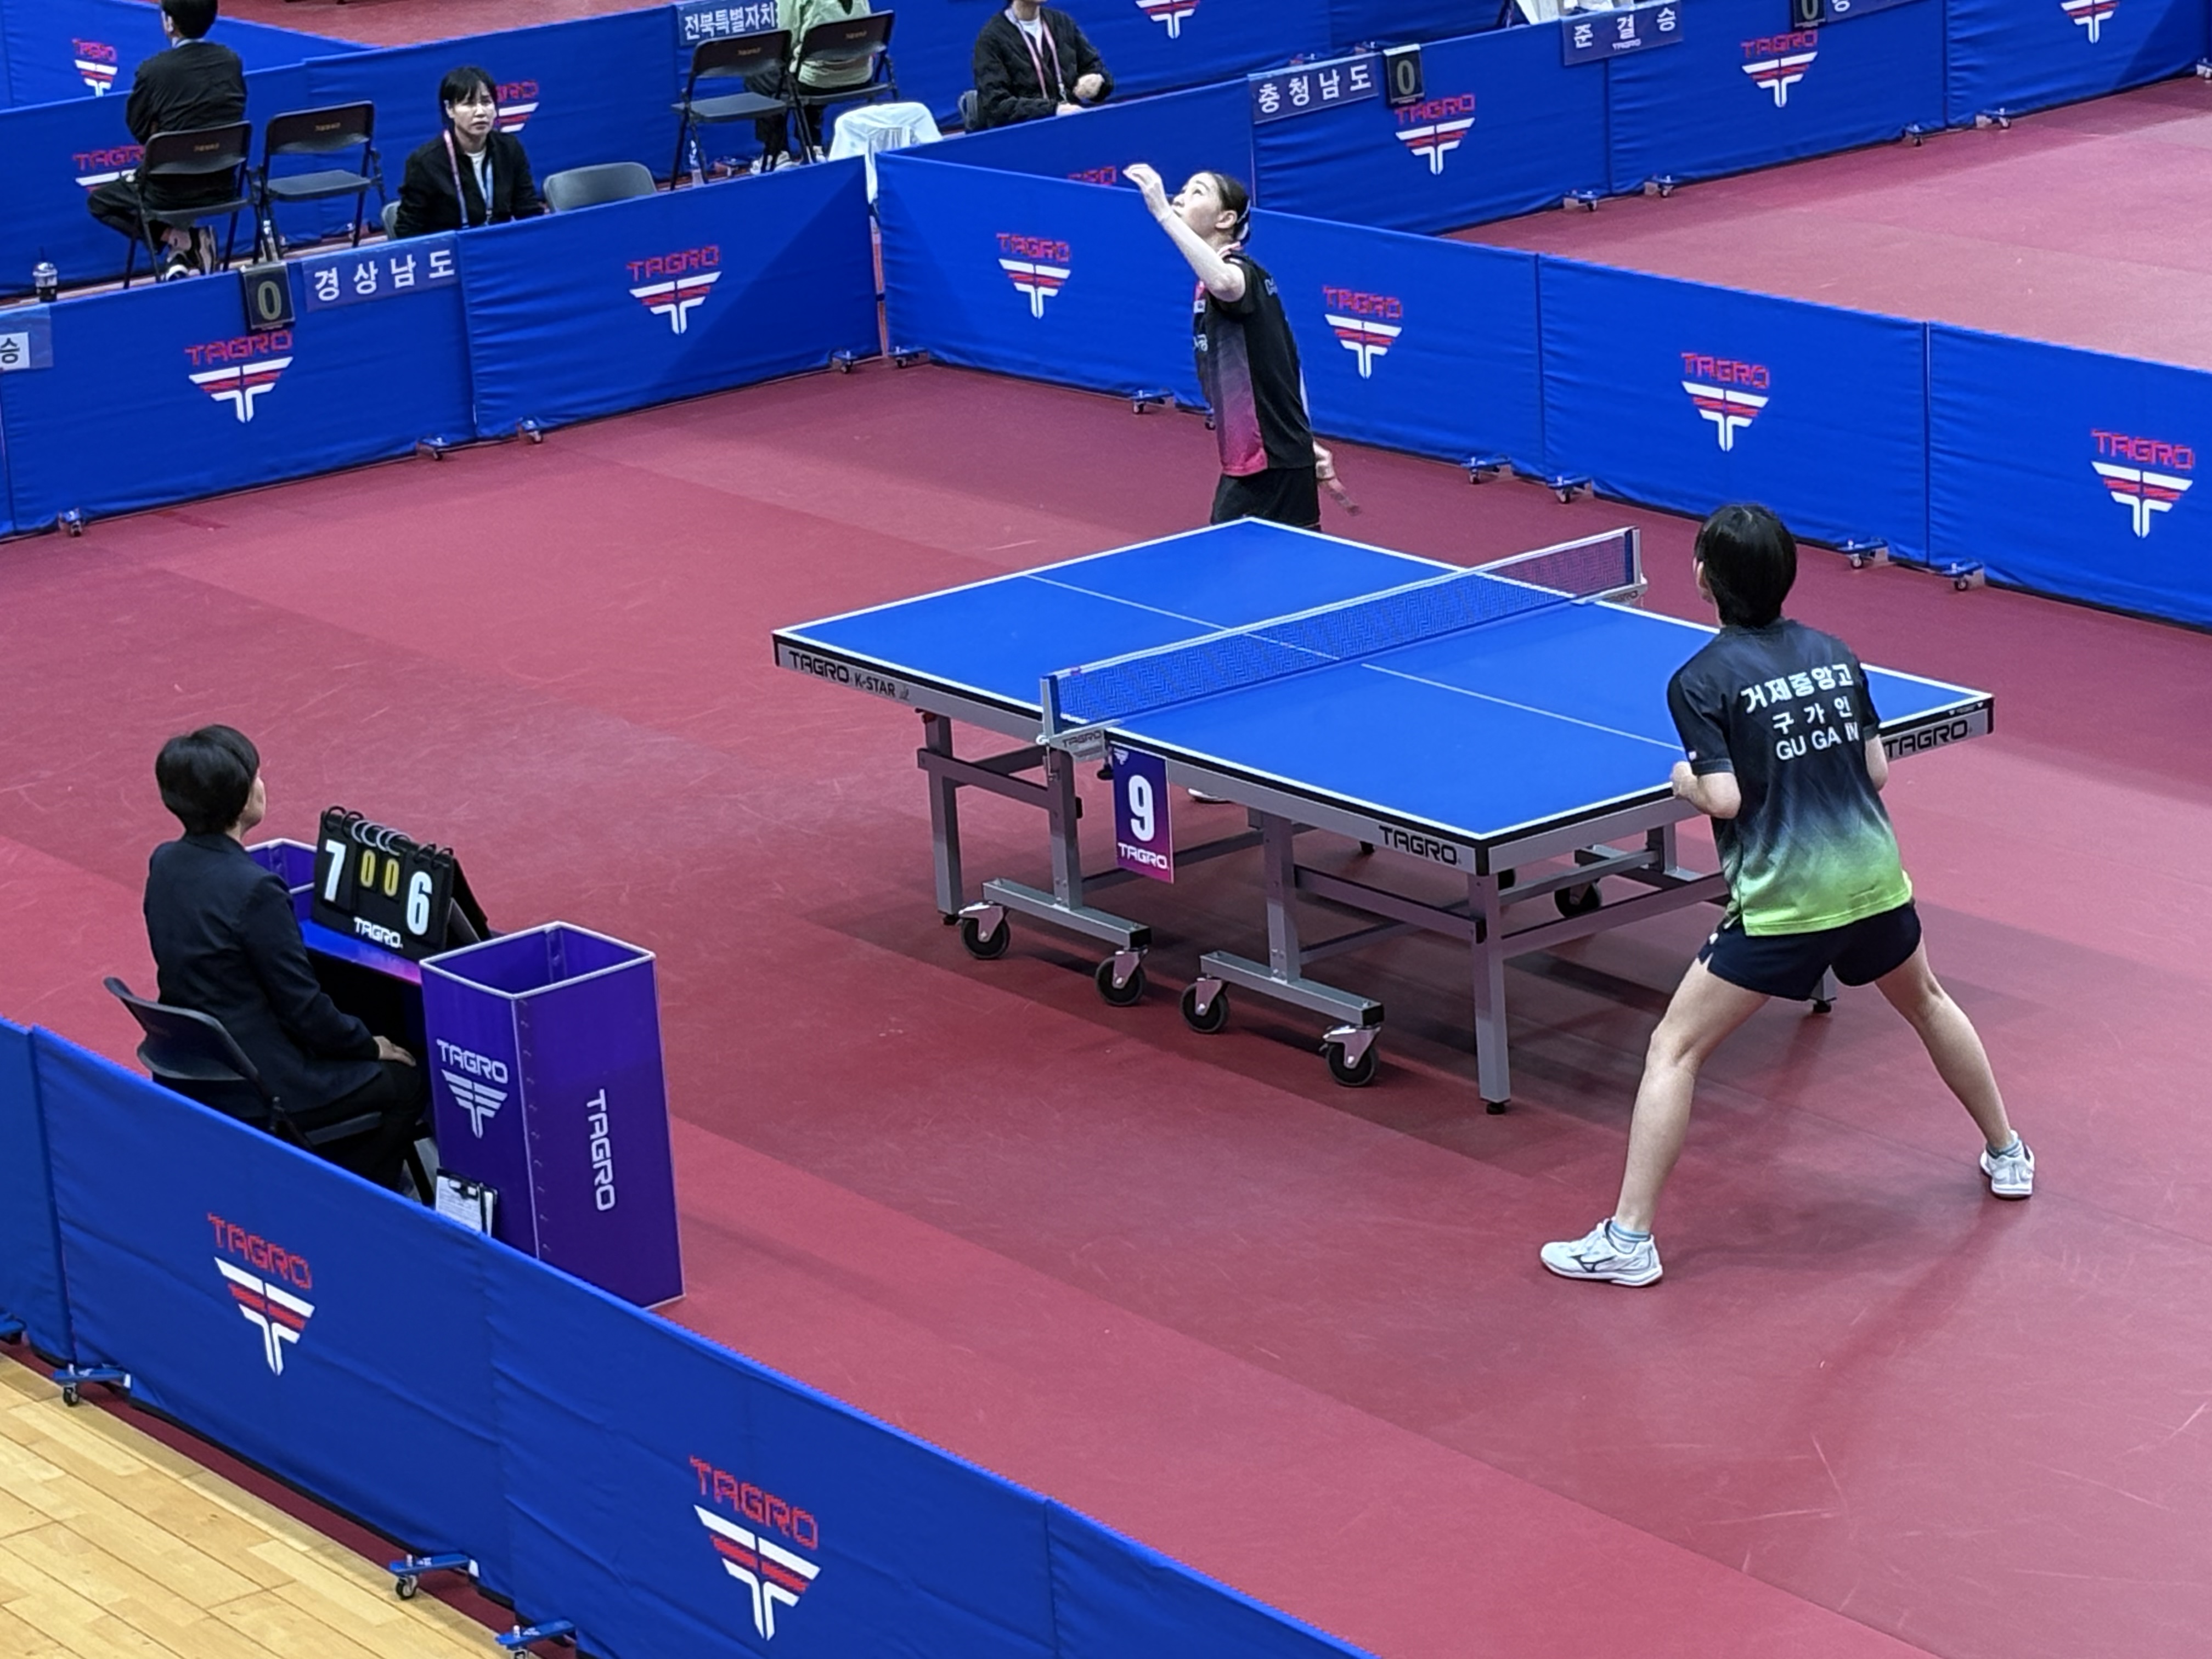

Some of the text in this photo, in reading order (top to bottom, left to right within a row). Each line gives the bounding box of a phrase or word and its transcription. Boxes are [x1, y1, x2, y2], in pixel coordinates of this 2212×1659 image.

[684, 2, 777, 41] 전북특별자치
[1741, 29, 1819, 58] TAGRO
[1397, 60, 1415, 95] 0
[1394, 94, 1475, 125] TAGRO
[72, 145, 146, 171] TAGR
[626, 245, 721, 282] TAGRO
[996, 233, 1071, 262] TAGRO
[258, 281, 281, 320] 0
[1323, 285, 1403, 319] TAGRO
[184, 330, 293, 366] TAGRO
[1681, 352, 1770, 389] TAGRO
[2091, 429, 2194, 470] TAGRO
[789, 651, 895, 697] TAGRO K-STAR
[1741, 664, 1854, 713] 거제중앙고
[1776, 735, 1807, 760] GU
[1812, 726, 1842, 750] GA
[1883, 719, 1967, 758] TAGRO
[1128, 775, 1154, 841] 9
[1118, 843, 1168, 870] TAGRO
[1379, 825, 1457, 865] TAGRO
[324, 839, 432, 935] 7 0 0 6
[354, 917, 401, 949] TAGRO
[437, 1039, 508, 1084] TAGRO
[586, 1089, 615, 1211] TAGRO
[207, 1212, 312, 1290] TAGRO
[689, 1455, 819, 1550] TAGRO
